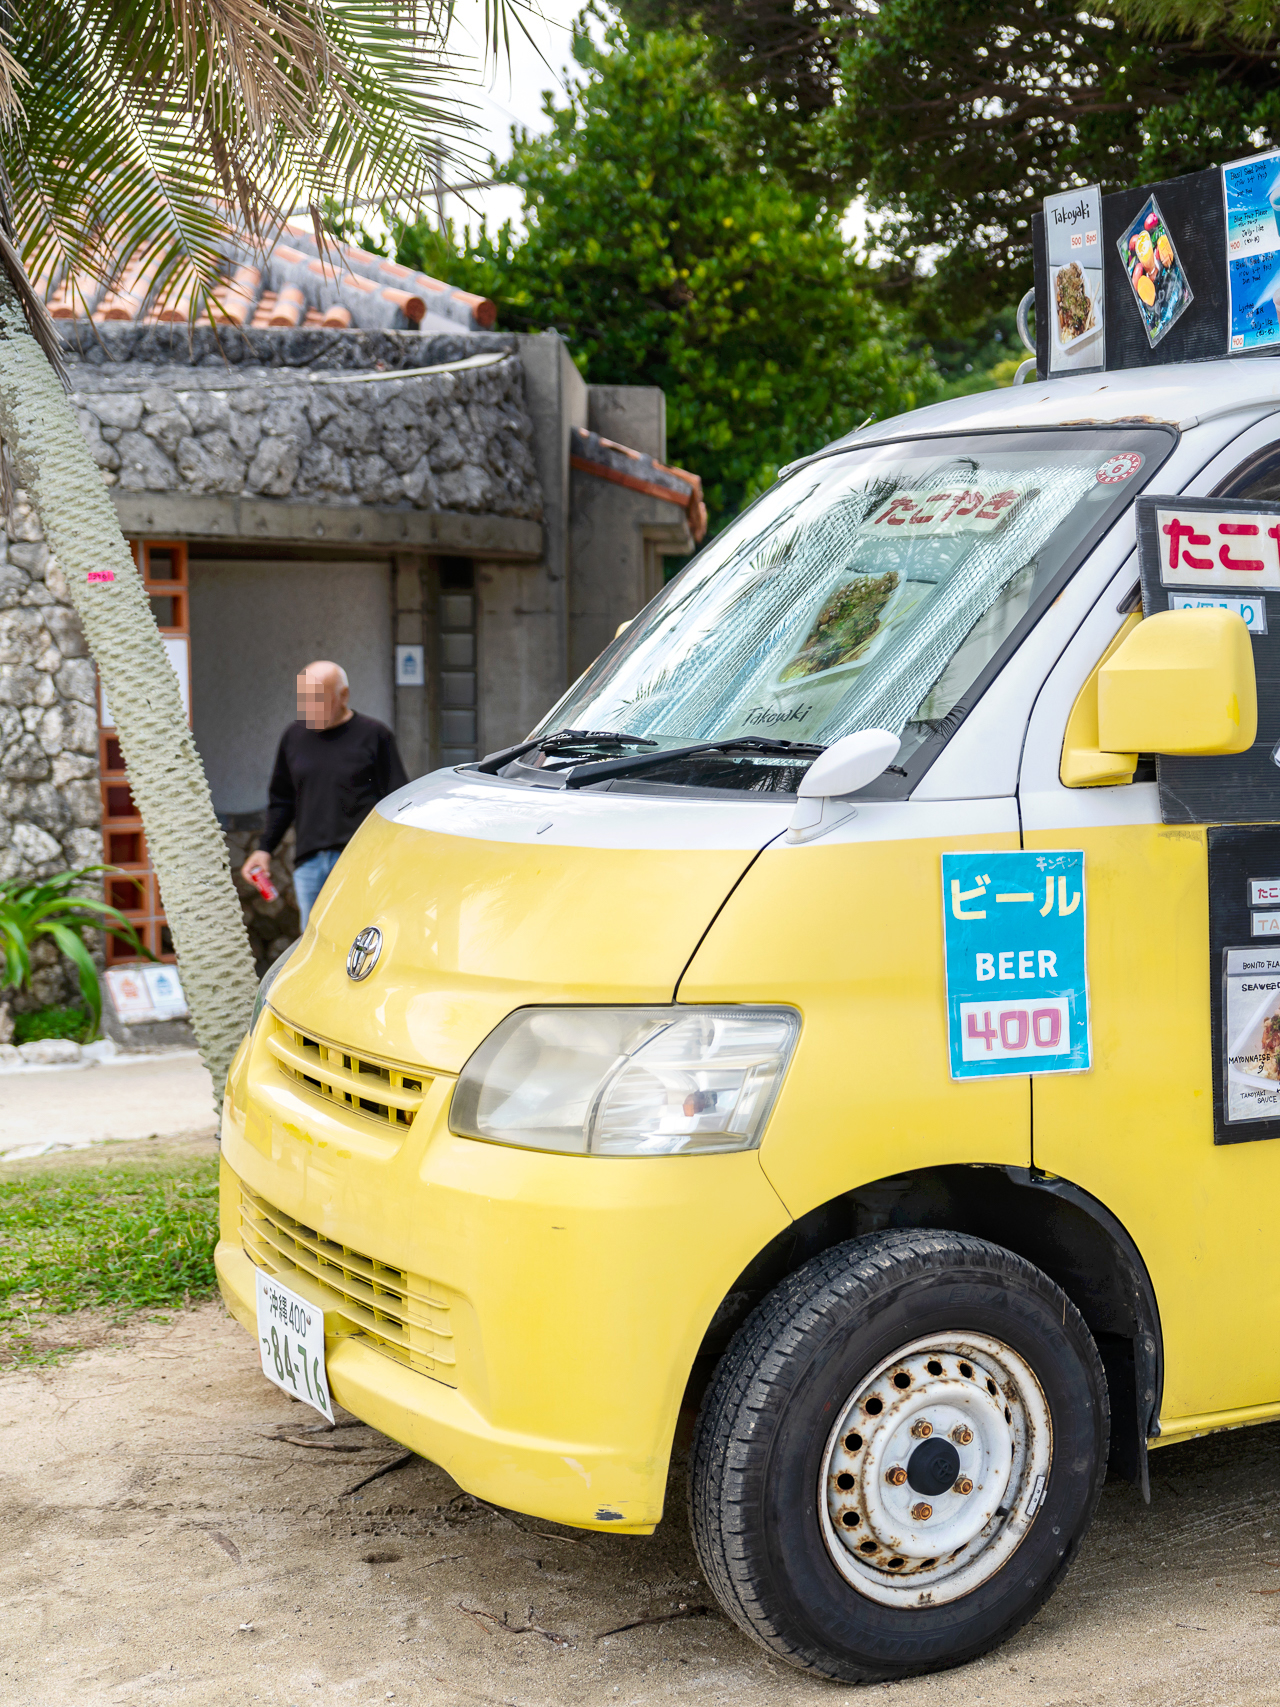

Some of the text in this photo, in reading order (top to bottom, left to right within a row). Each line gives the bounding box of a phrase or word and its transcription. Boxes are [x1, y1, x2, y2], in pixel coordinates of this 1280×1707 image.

[1051, 200, 1090, 226] Takoyaki
[1070, 236, 1082, 247] 500
[874, 488, 1021, 526] たこやき
[740, 703, 813, 729] Takoyaki
[950, 873, 1081, 920] ビール
[976, 950, 1058, 982] BEER
[1242, 961, 1266, 970] BONITO
[966, 1006, 1062, 1052] 400
[1228, 1054, 1271, 1064] MAYONNAISE
[1257, 1096, 1278, 1104] SAUCE
[269, 1287, 307, 1338] 沖縄 400
[271, 1325, 327, 1411] 84-76
